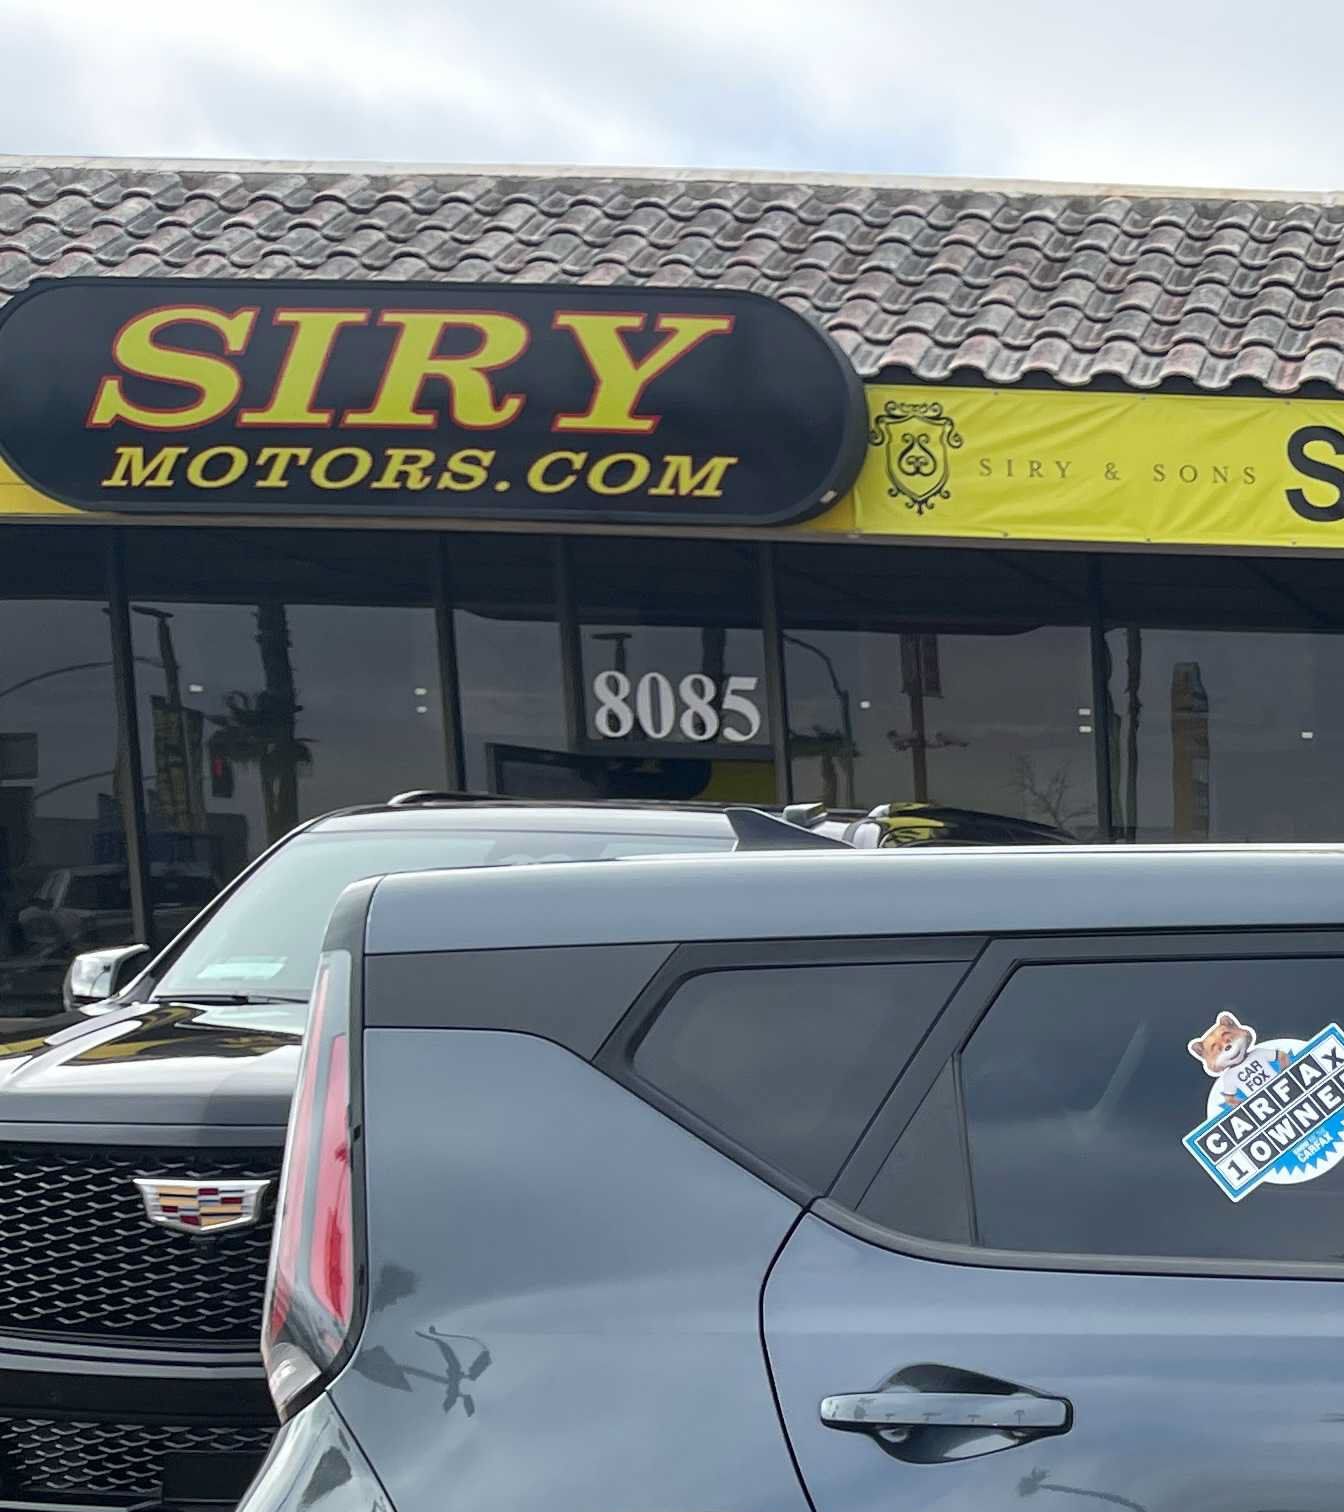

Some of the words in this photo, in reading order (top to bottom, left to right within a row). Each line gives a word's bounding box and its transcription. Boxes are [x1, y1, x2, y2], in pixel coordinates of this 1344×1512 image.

[86, 304, 735, 433] SIRY
[101, 445, 738, 498] MOTORS.COM
[979, 458, 1071, 479] SIRY
[1104, 462, 1120, 481] &
[1152, 463, 1256, 485] SONS
[593, 670, 762, 742] 8085
[1237, 1060, 1263, 1081] CAR
[1245, 1069, 1270, 1091] FOX
[1228, 1160, 1249, 1180] 1
